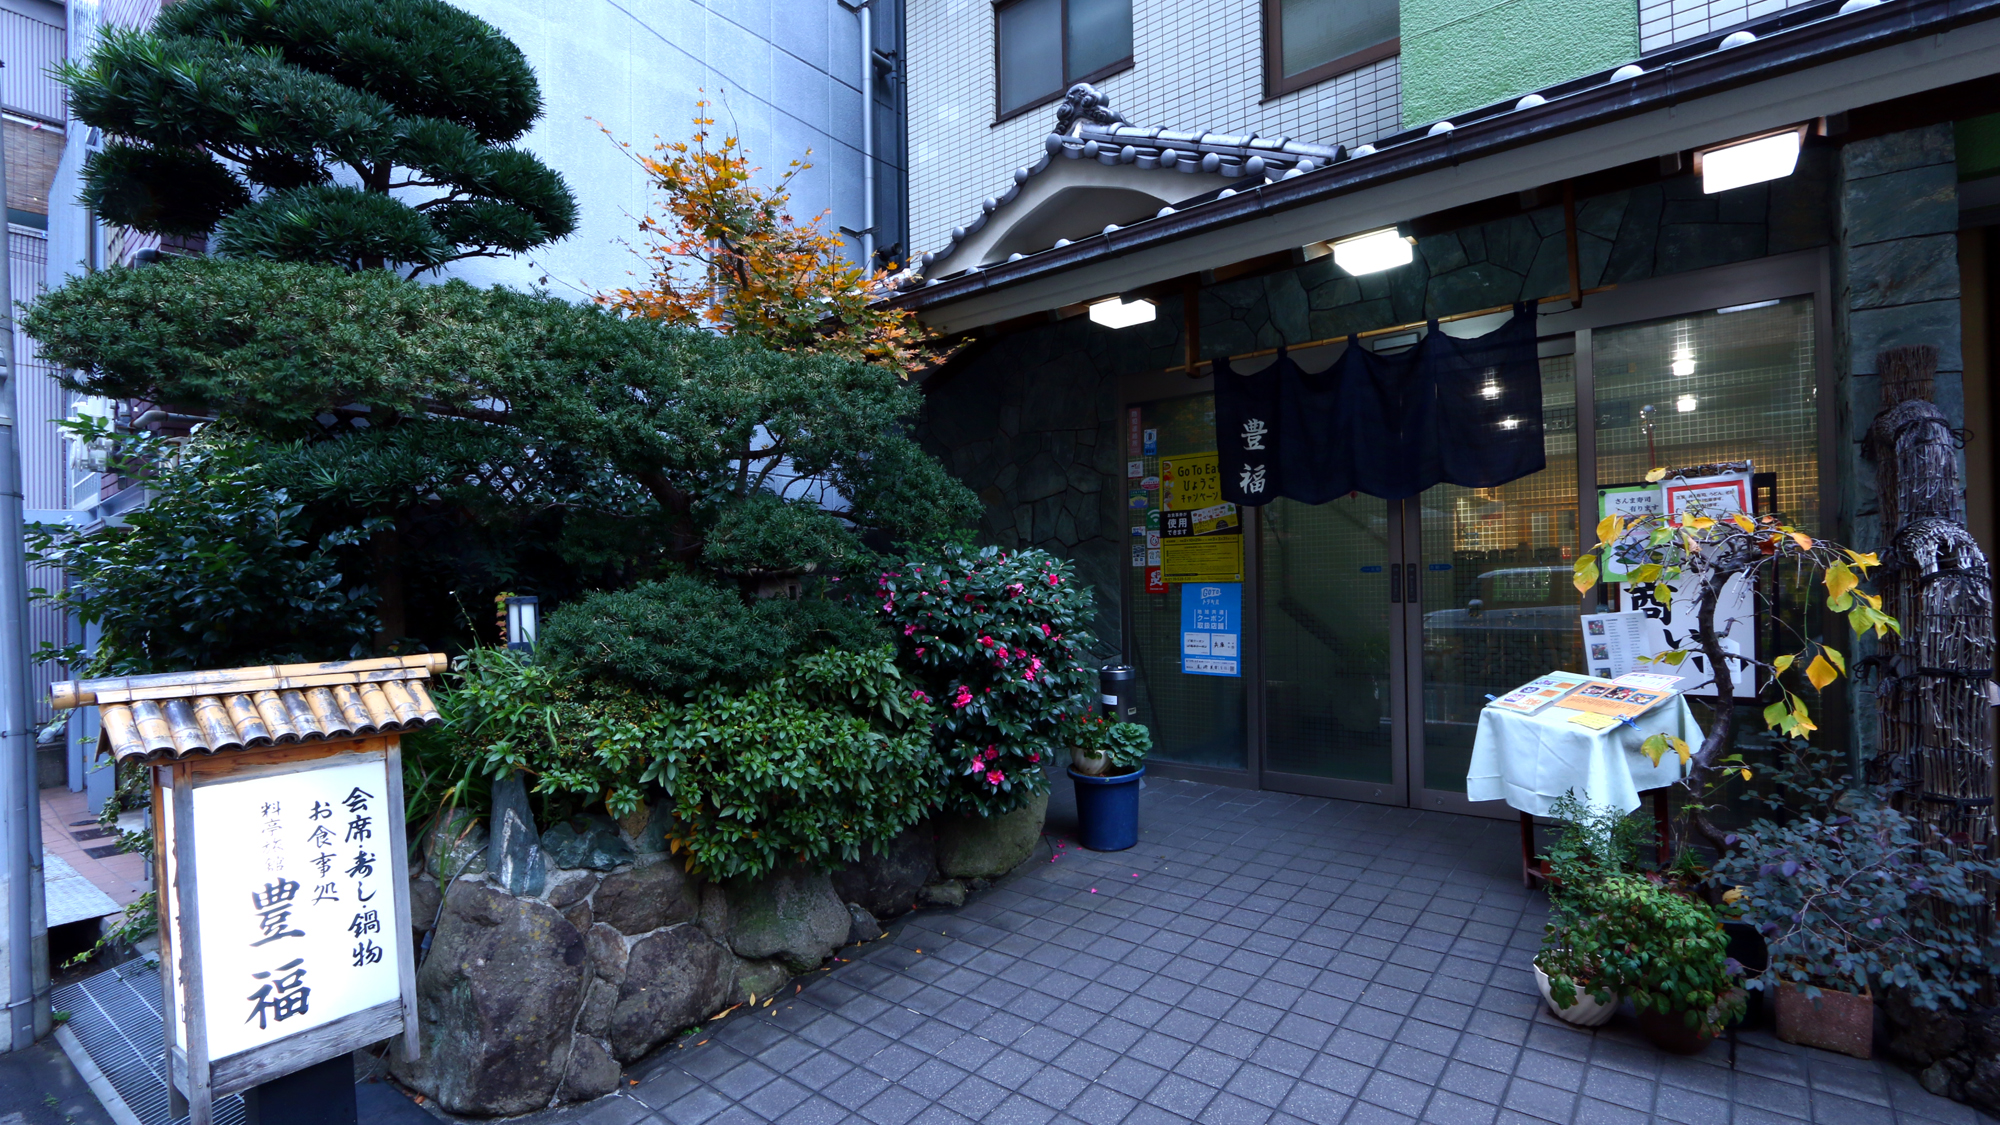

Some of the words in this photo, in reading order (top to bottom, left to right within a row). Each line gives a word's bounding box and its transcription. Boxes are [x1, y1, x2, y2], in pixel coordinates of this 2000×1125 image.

[1239, 418, 1269, 495] 豊福
[1178, 466, 1190, 477] Go
[1193, 465, 1202, 475] To
[1183, 476, 1216, 491] ひょうご
[1181, 491, 1219, 503] キャンペーン
[1615, 495, 1651, 505] さんま寿司
[1629, 504, 1659, 512] 有ります
[1167, 518, 1187, 529] 使用
[260, 800, 285, 872] 料亭旅館
[307, 801, 340, 905] お食事処
[245, 877, 312, 1030] 豊福
